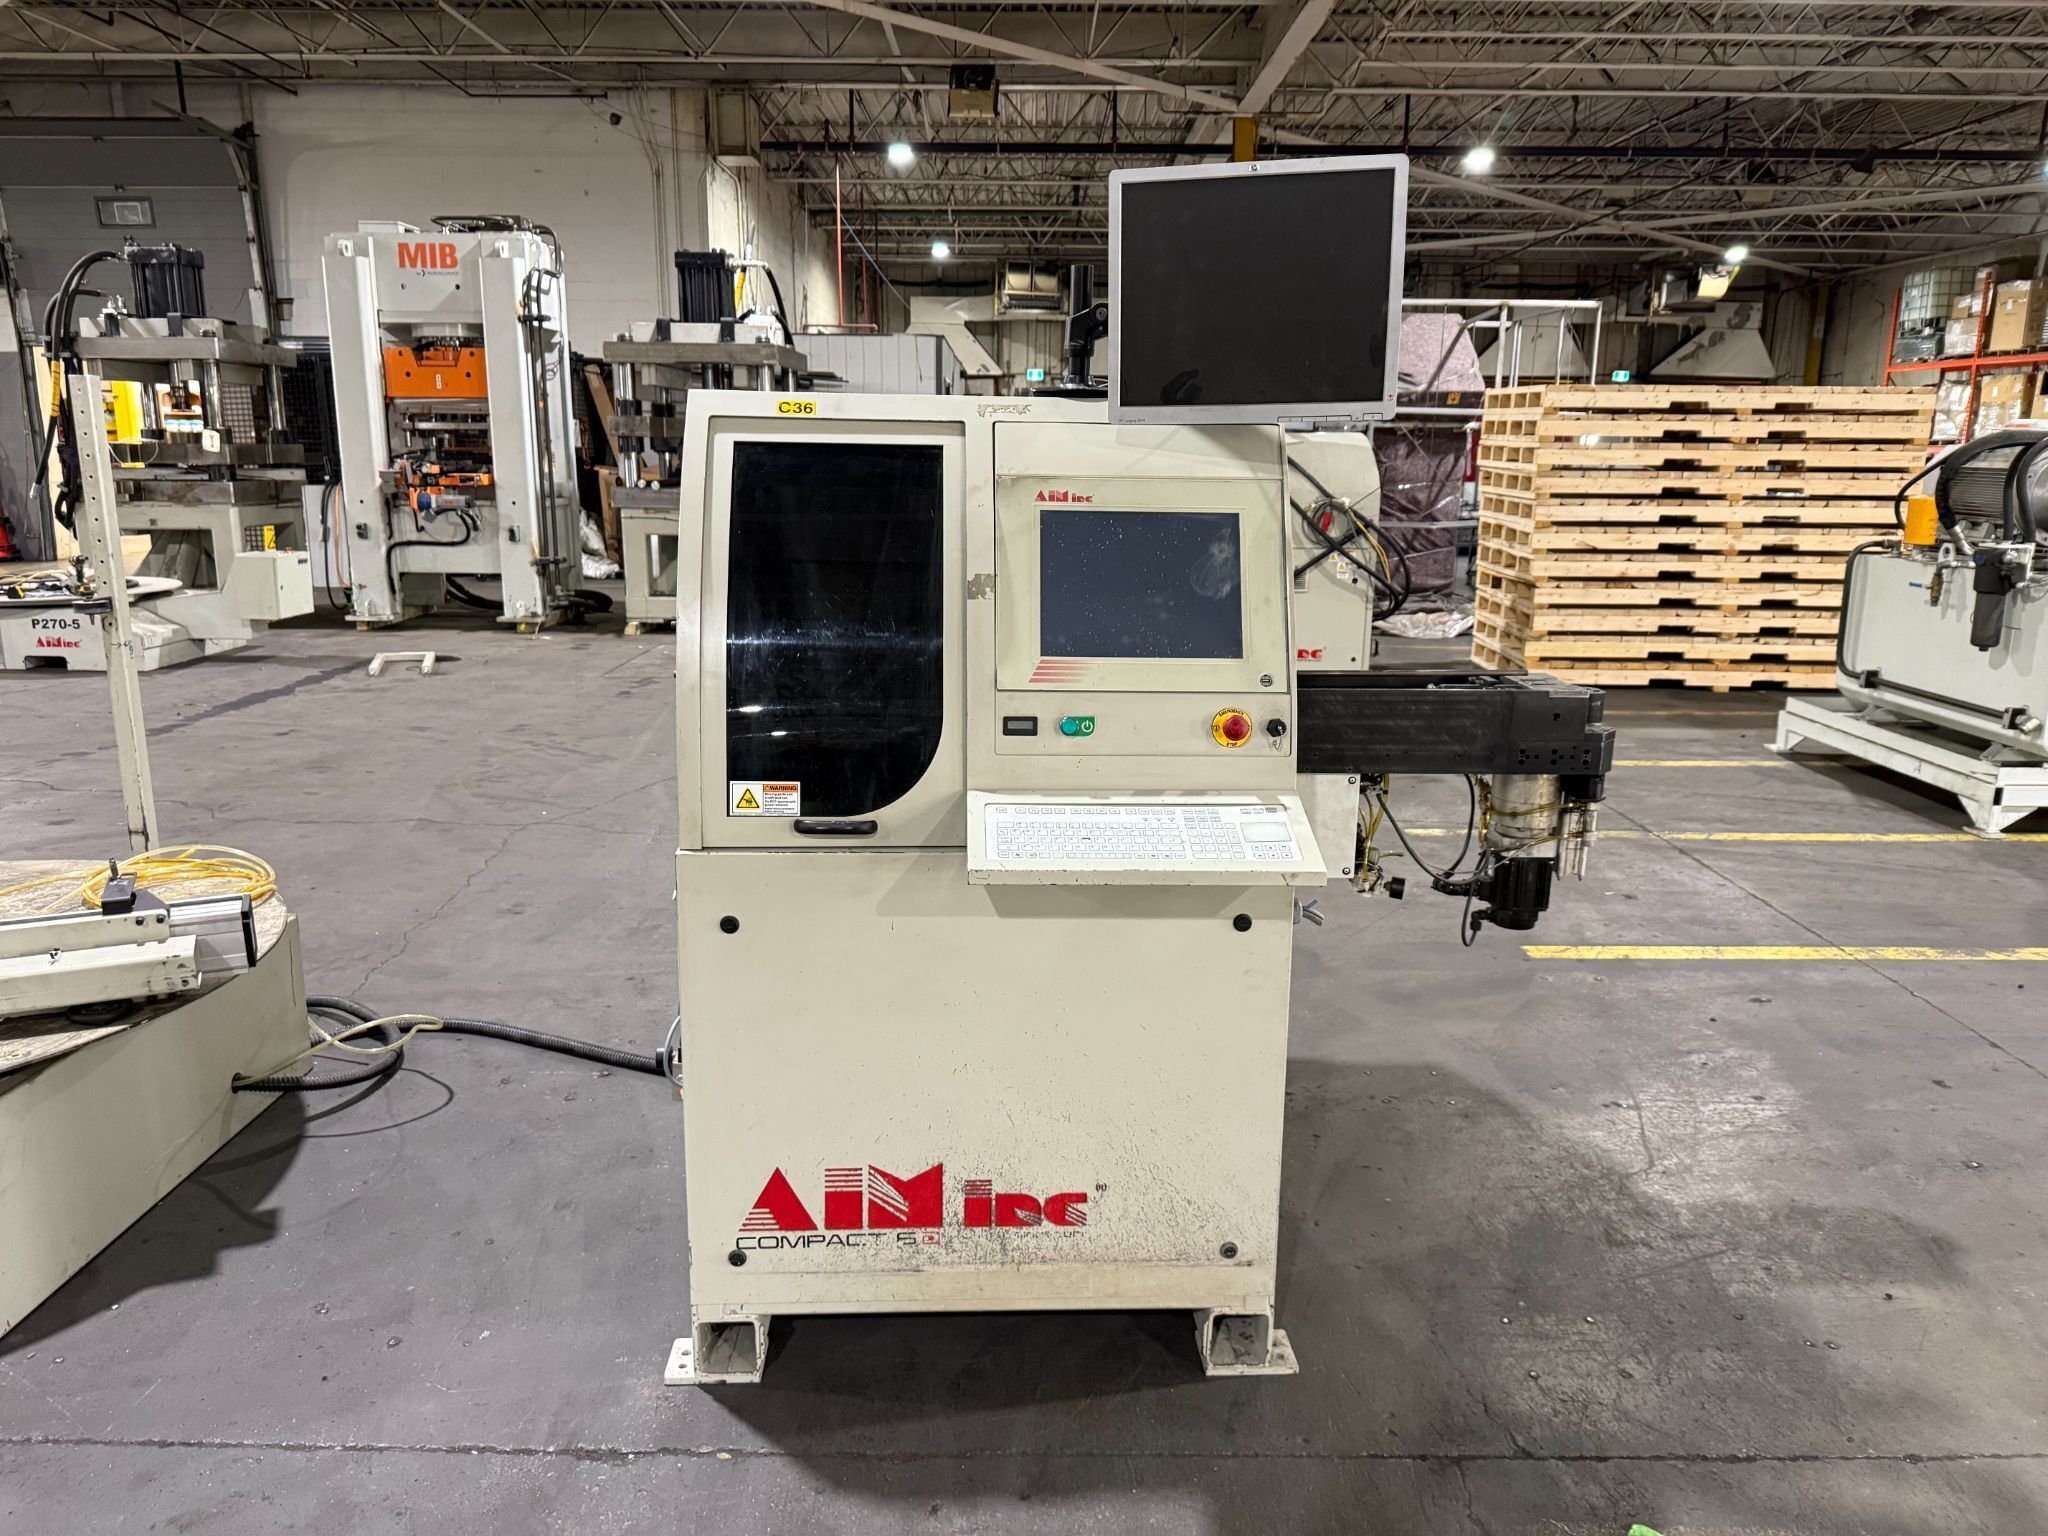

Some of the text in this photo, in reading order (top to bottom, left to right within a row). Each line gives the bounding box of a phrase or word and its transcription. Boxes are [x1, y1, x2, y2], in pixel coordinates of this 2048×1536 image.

[397, 242, 459, 269] MIB
[778, 401, 814, 414] C36
[31, 618, 81, 629] P270-5
[736, 1232, 887, 1250] COMPACT
